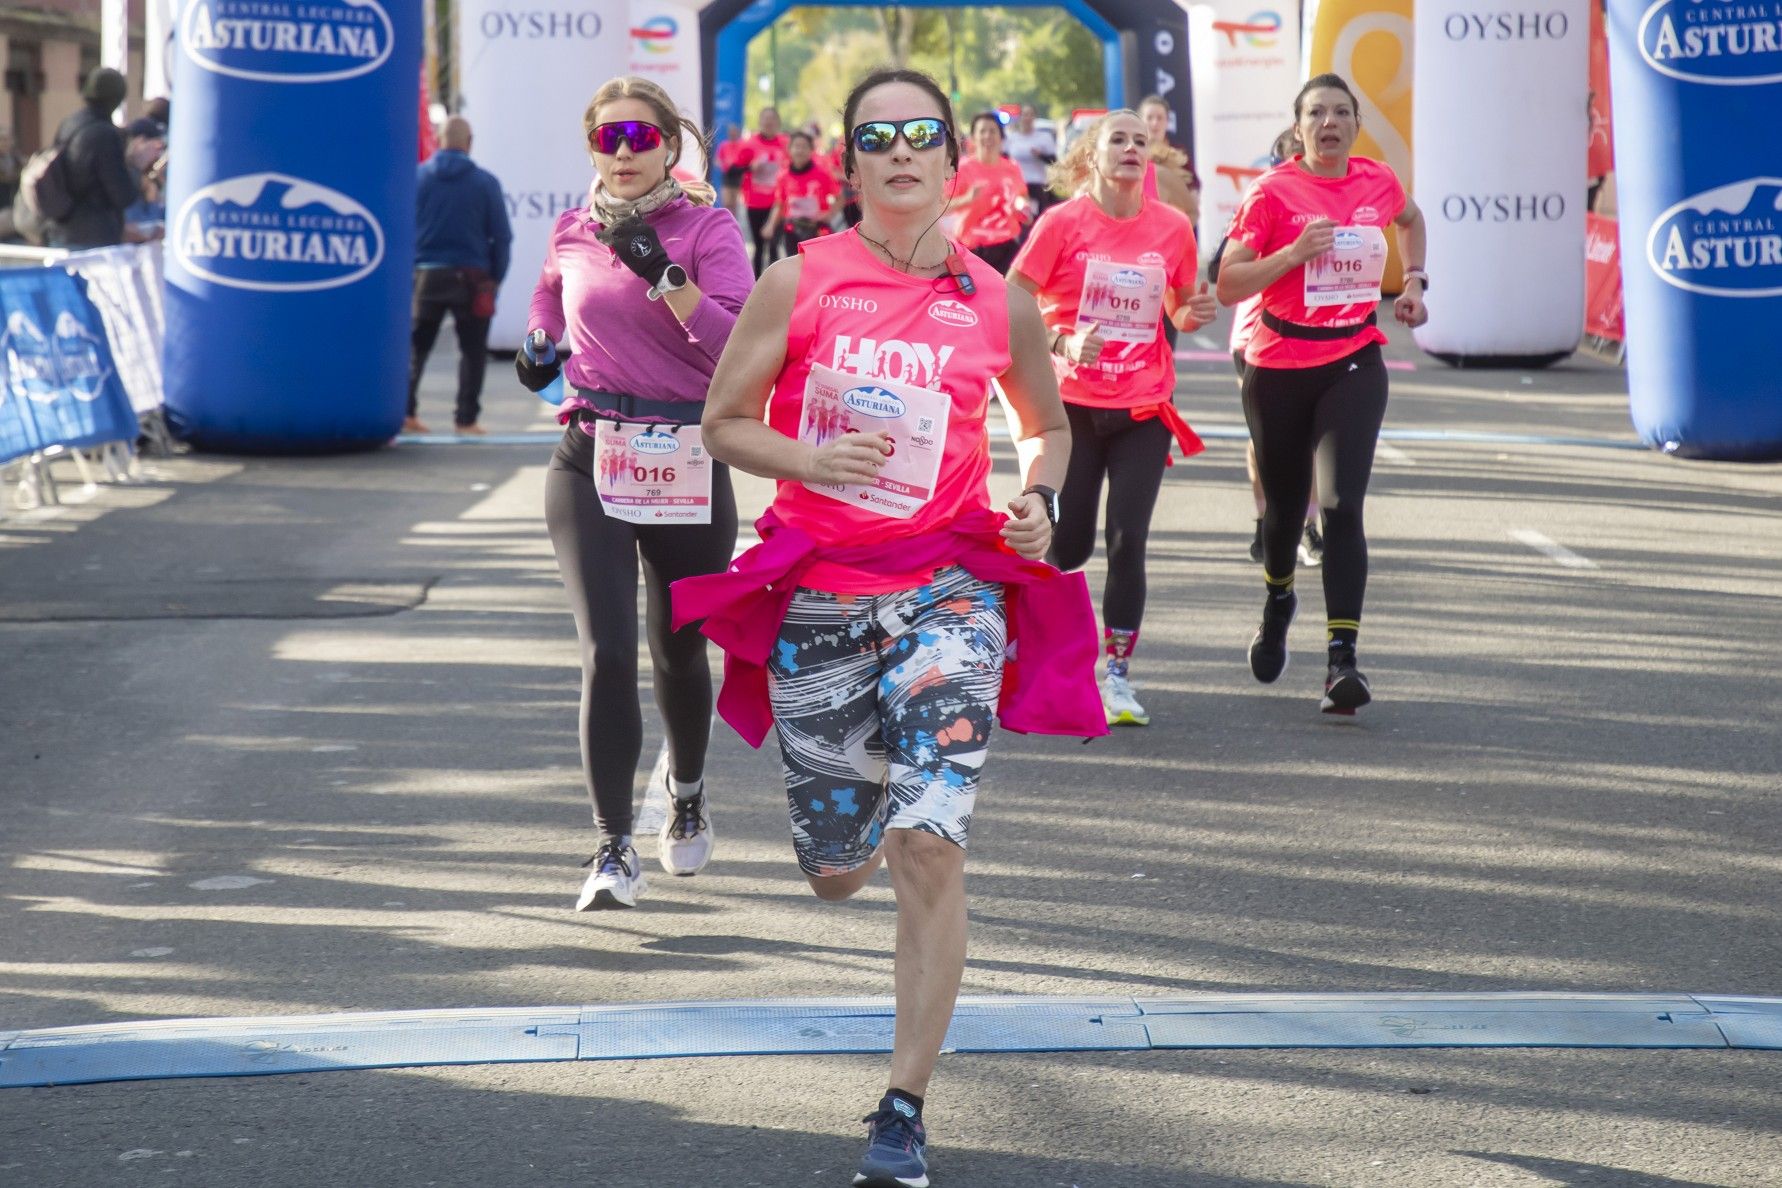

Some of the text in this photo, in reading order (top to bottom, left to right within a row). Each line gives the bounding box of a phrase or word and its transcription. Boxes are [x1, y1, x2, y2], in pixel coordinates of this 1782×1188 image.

[1685, 4, 1768, 22] CENTRAL
[190, 3, 378, 58] ASTURIANA
[480, 10, 602, 39] OYSHO
[1444, 9, 1568, 41] OYSHO
[1442, 192, 1565, 222] OYSHO
[1693, 217, 1776, 235] CENTRAL
[183, 211, 369, 265] ASTURIANA
[1334, 259, 1362, 273] 016
[818, 294, 878, 313] OYSHO
[1110, 296, 1141, 312] 016
[831, 334, 956, 392] HOY
[814, 386, 839, 401] SUMA
[846, 393, 900, 415] ASTURIANA
[632, 438, 677, 450] ASTURIANA
[633, 466, 676, 483] 016
[884, 481, 911, 494] SEVILLA
[870, 494, 911, 512] Santander
[664, 510, 698, 518] Santander
